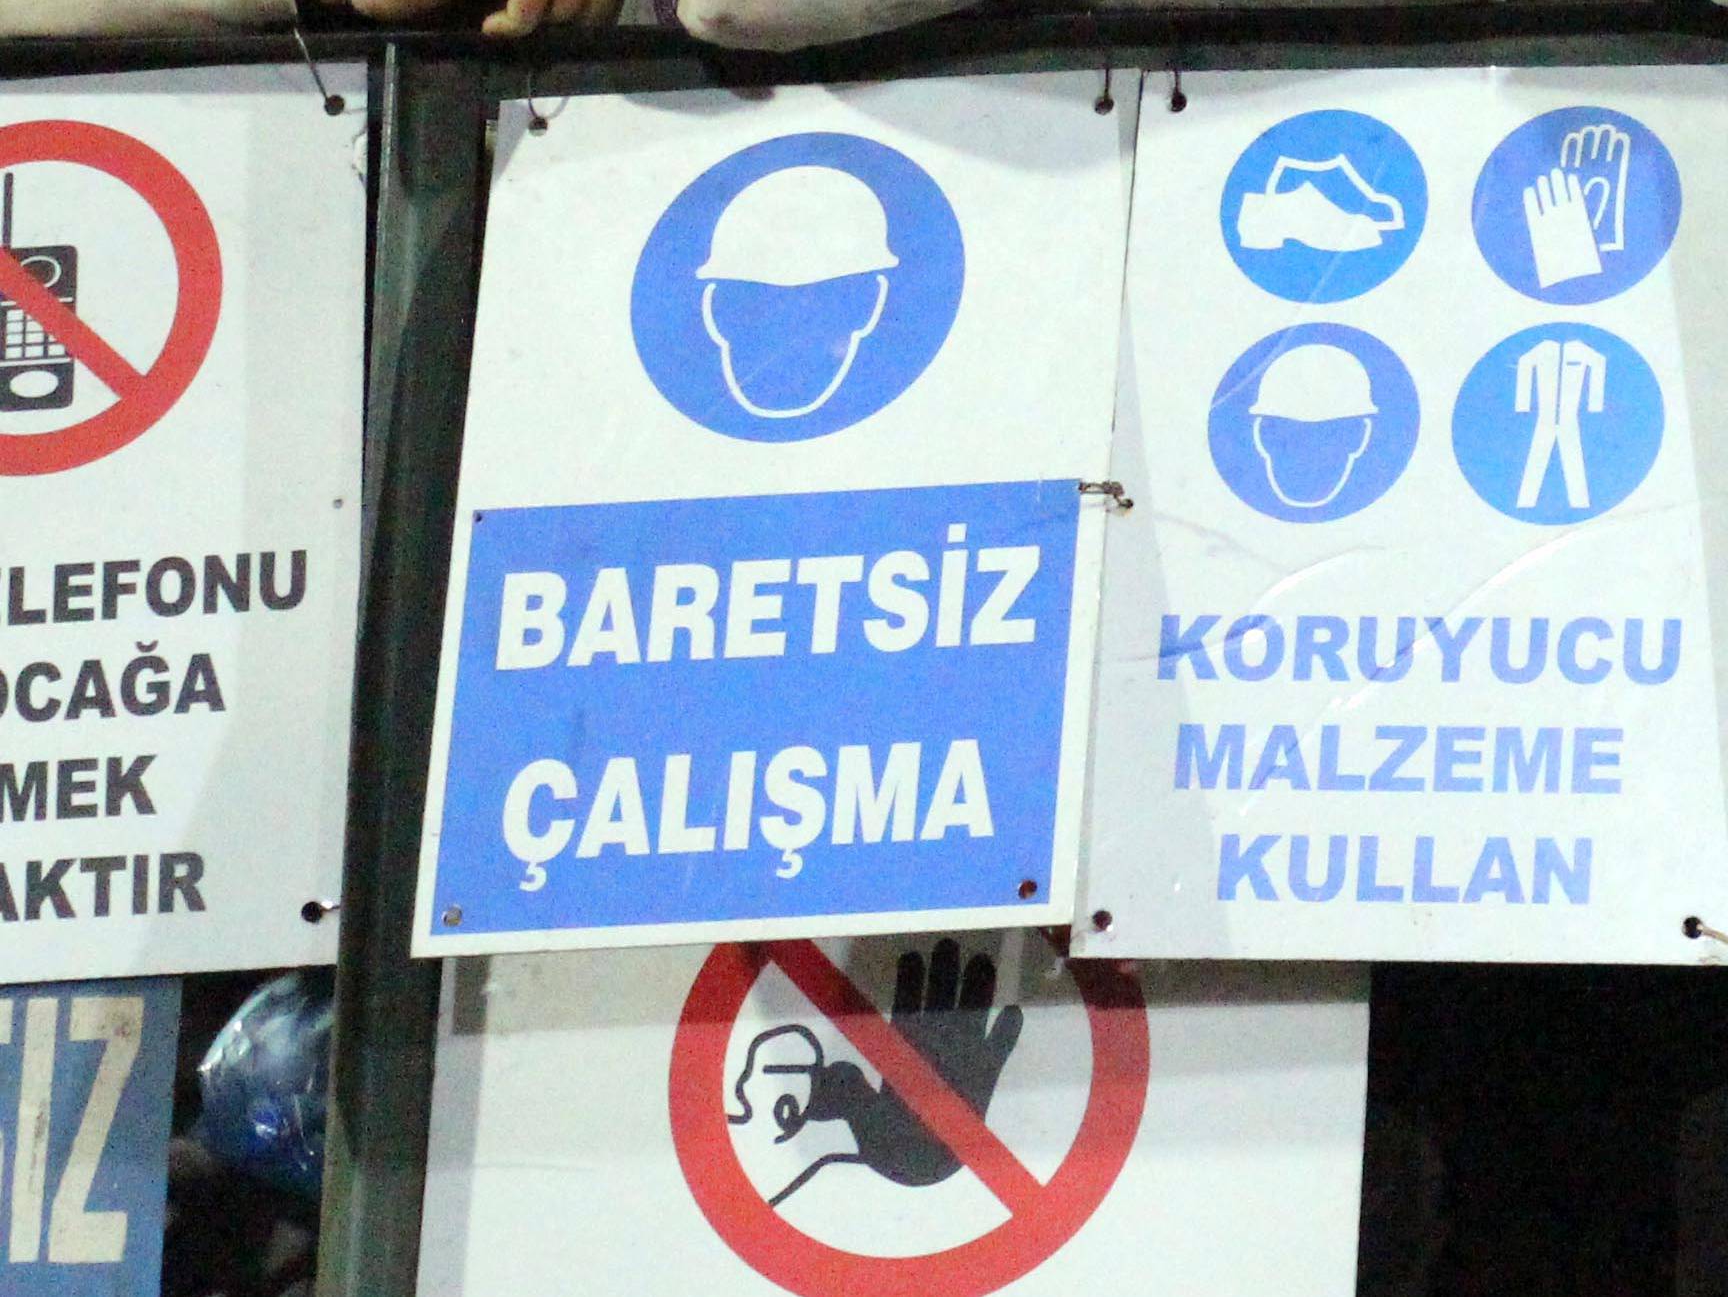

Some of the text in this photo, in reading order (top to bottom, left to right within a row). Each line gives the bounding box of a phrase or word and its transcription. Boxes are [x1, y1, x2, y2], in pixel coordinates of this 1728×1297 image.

[0, 549, 307, 626] LEFONU
[495, 523, 1041, 671] BARETSİZ
[0, 640, 227, 723] CAĞA
[1156, 614, 1683, 685] KORUYUCU
[1173, 724, 1625, 796] MALZEME
[502, 738, 994, 892] ÇALIŞMA
[1216, 834, 1594, 905] KULLAN
[0, 996, 145, 1264] IZ
